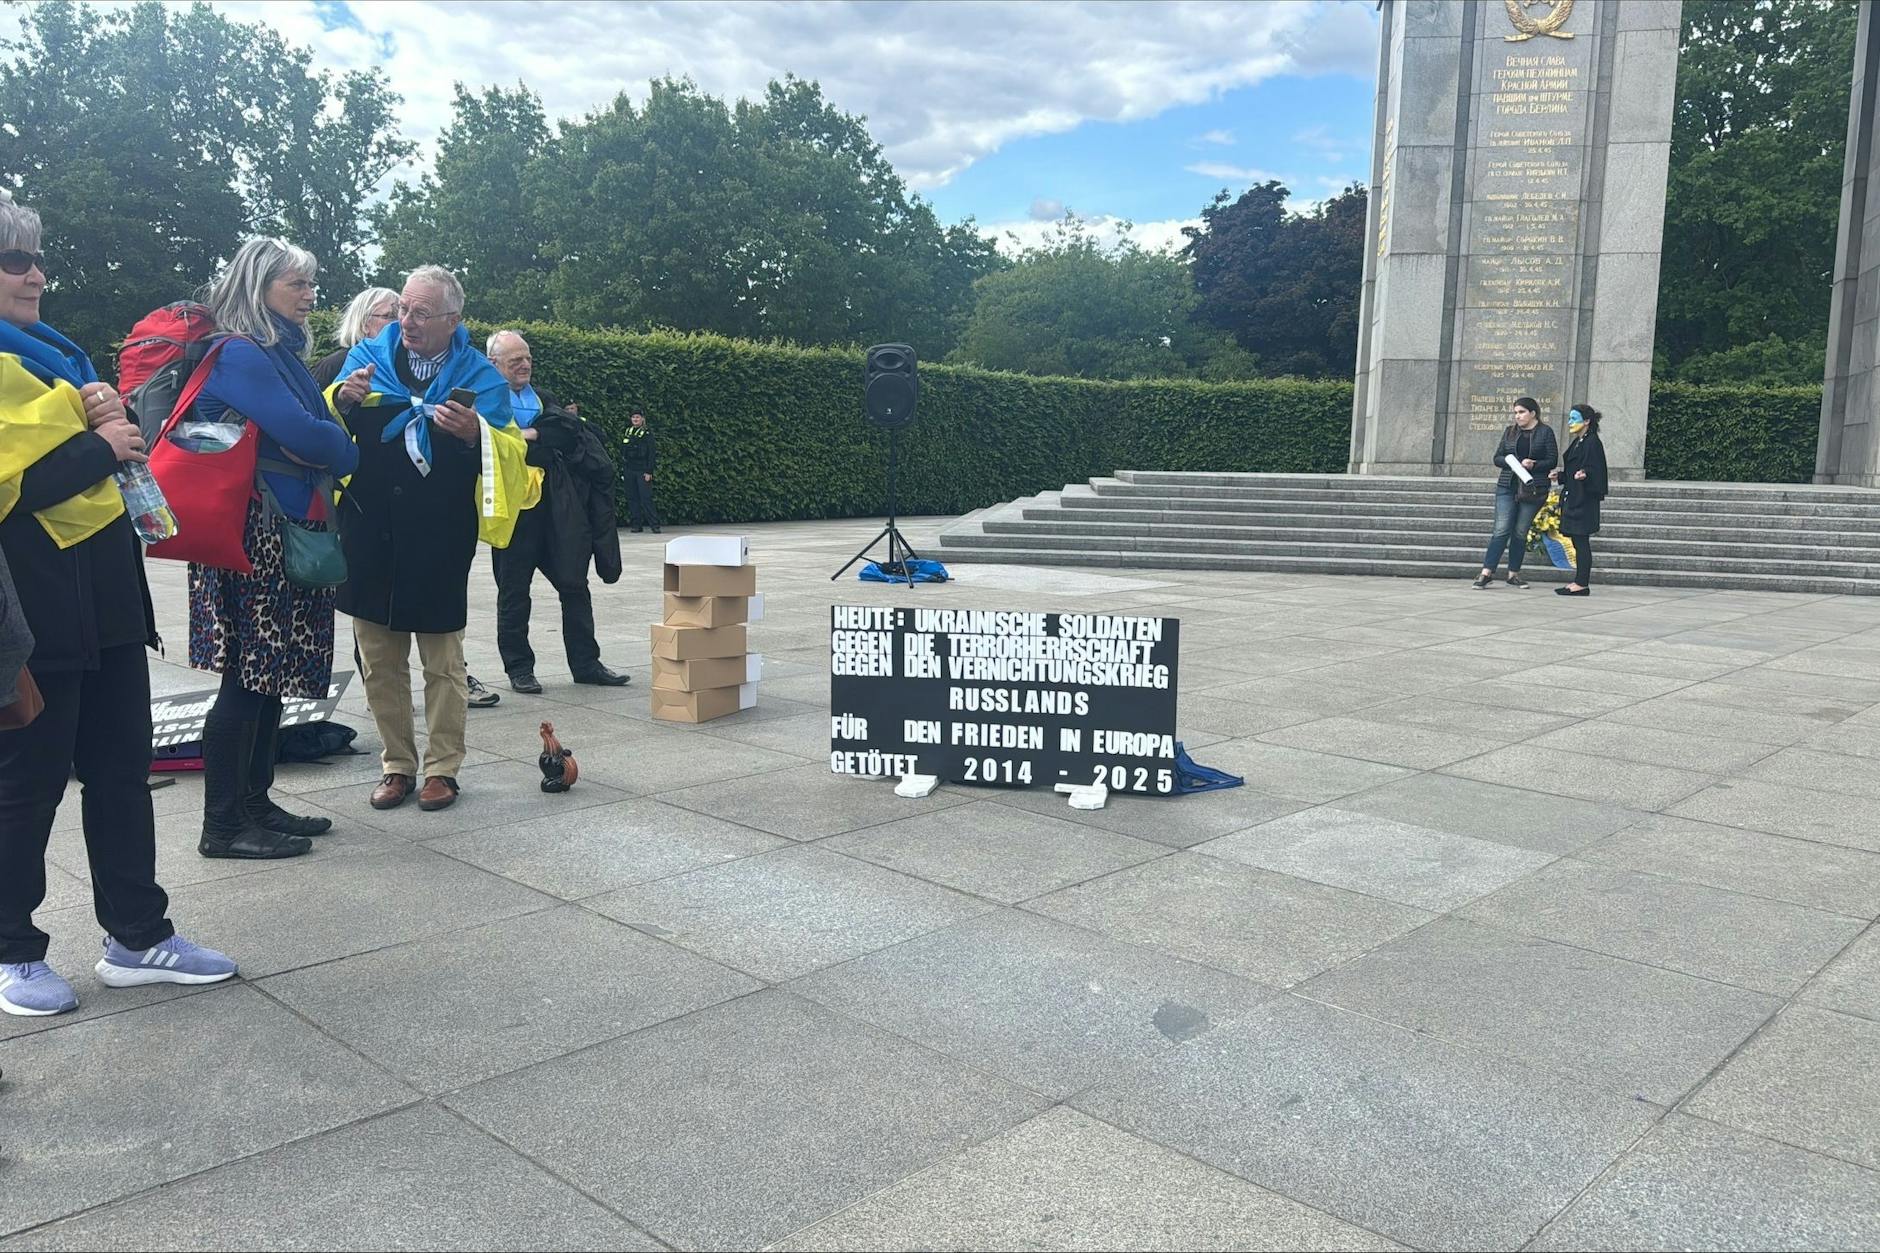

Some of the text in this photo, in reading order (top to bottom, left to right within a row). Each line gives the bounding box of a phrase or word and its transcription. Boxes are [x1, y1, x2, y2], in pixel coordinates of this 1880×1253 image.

[834, 606, 1162, 641] HEUTE: UKRAINISCHE SOLDATEN
[832, 630, 1155, 664] GEGEN DIE TERRORHERRSCHAFT
[832, 653, 1169, 689] GEGEN DEN VERNICHTUNGSKRIEG
[950, 686, 1089, 716] RUSSLANDS
[831, 713, 1175, 759] FÜR DEN FRIEDEN IN EUROPA
[830, 749, 918, 776] GETÖTET
[963, 757, 1033, 784] 2014
[1093, 764, 1173, 793] 2025
